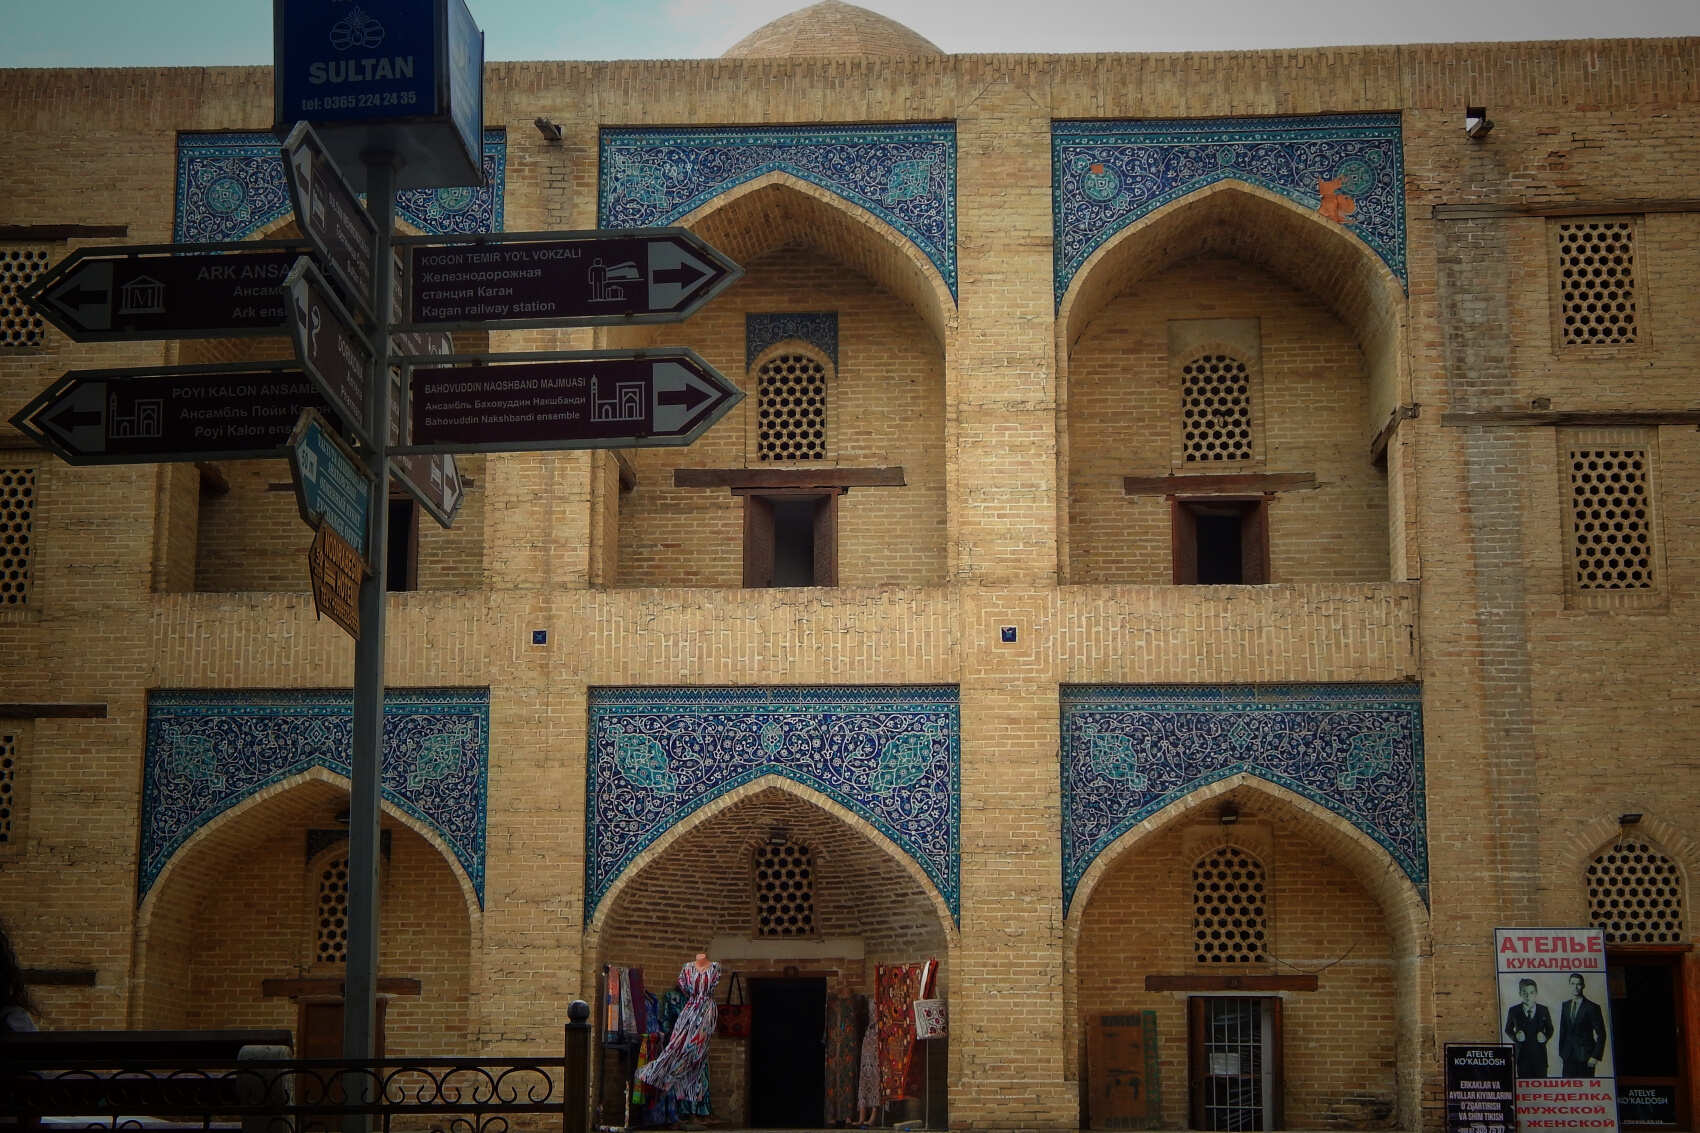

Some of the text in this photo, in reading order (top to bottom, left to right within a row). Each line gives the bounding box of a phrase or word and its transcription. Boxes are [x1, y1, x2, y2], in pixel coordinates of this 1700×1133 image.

[308, 56, 414, 84] SULTAN
[301, 97, 322, 110] tel:
[358, 94, 381, 107] 224
[421, 248, 582, 266] KOGON TEMIR YO'L VOKZALI
[197, 265, 237, 280] ARK
[421, 268, 542, 283] Железнодорожная
[421, 286, 513, 301] станция Каган
[232, 306, 256, 319] Ark
[421, 301, 556, 318] Kagan railway station
[172, 385, 205, 399] POYI
[208, 384, 256, 397] KALON
[424, 381, 482, 394] BAHOVUDDIN
[540, 377, 586, 389] MAJMUASI
[179, 406, 248, 420] Ансамбль
[424, 411, 581, 426] Bahovuddin Nakshbandi ensemble
[194, 425, 224, 439] Poyi
[227, 424, 264, 437] Kalon
[1500, 936, 1602, 954] АТЕЛЬЕ
[1506, 957, 1598, 971] КУКАЛДОШ
[1466, 1050, 1494, 1058] ATELYE
[1454, 1058, 1505, 1066] KO'KALDOSH
[1518, 1080, 1600, 1088] ПОШИВ И
[1628, 1089, 1656, 1097] ATELYE
[1517, 1105, 1605, 1114] МУЖСКОЙ
[1527, 1119, 1615, 1128] ЖЕНСКОЙ
